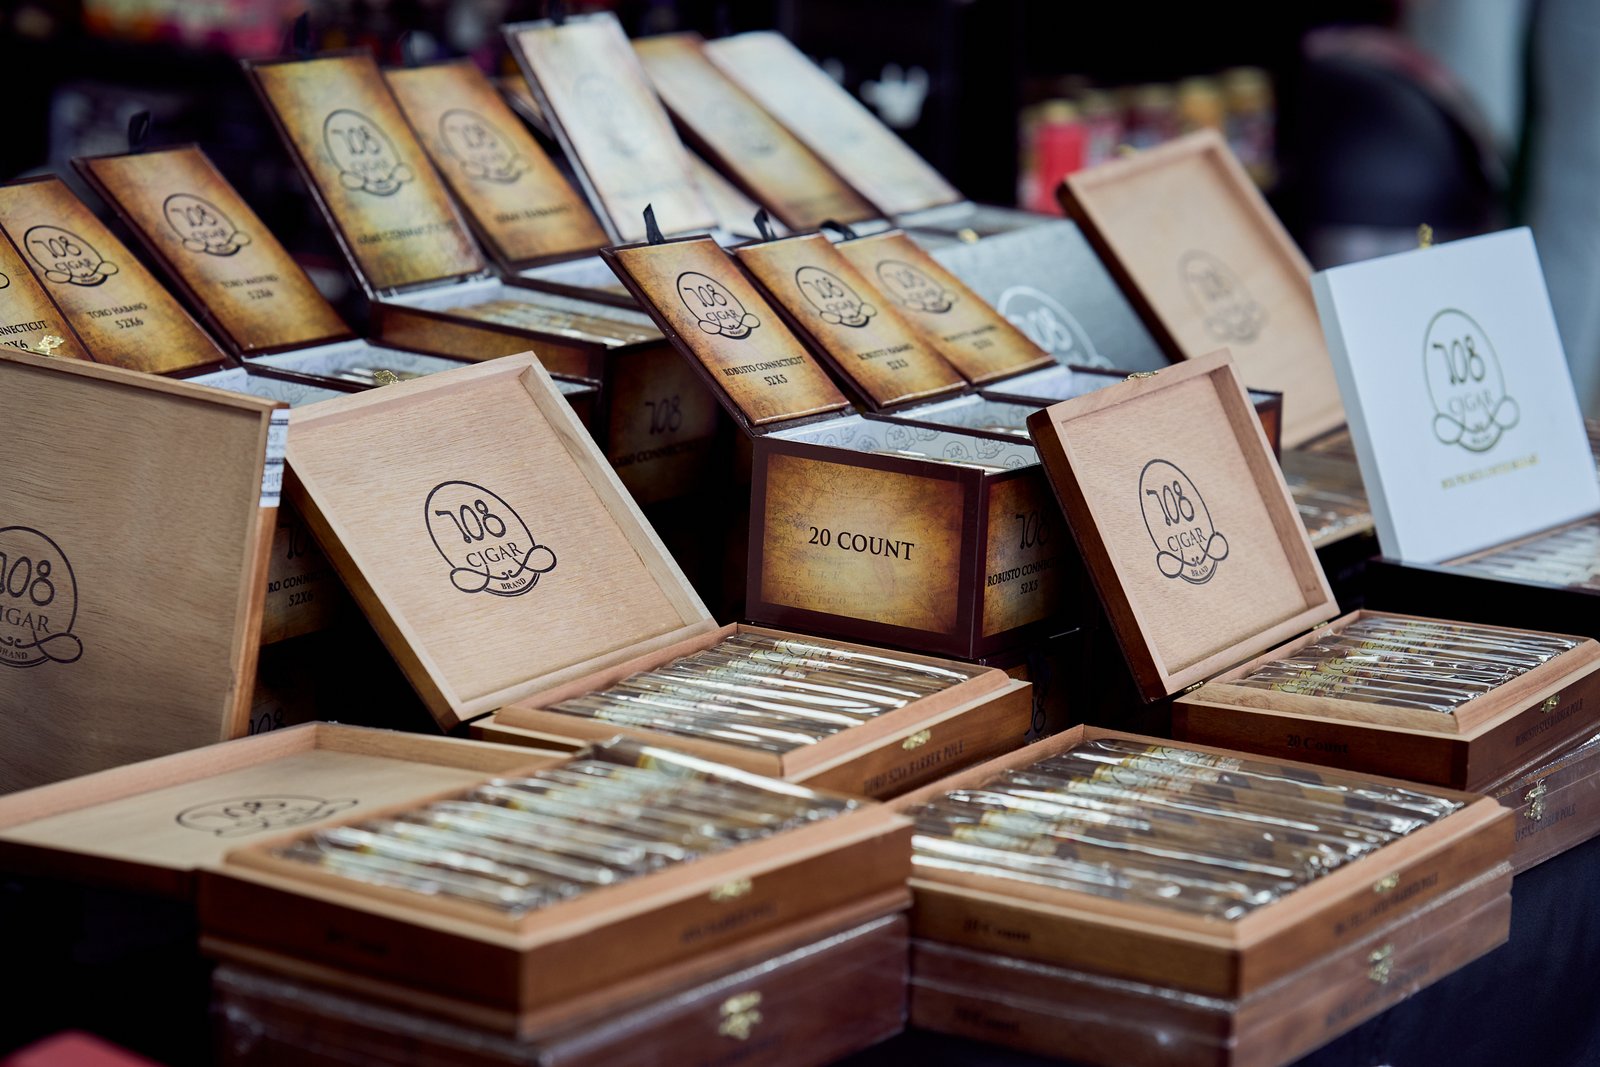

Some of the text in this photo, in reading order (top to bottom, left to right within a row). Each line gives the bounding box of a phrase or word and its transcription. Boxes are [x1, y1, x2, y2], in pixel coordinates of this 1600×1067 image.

[170, 204, 217, 227] 708
[31, 235, 82, 258] 708
[54, 258, 97, 272] CIGAR
[683, 284, 728, 308] 708
[802, 276, 844, 299] 708
[706, 309, 741, 322] CIGAR
[722, 355, 806, 377] ROBUSTO CONNECTICUT
[1431, 334, 1487, 386] 708
[763, 373, 788, 386] 52X5
[1448, 389, 1494, 416] CIGAR
[1145, 480, 1195, 527] 708
[435, 499, 507, 544] 708
[808, 526, 915, 561] 20 COUNT
[1166, 527, 1208, 553] CIGAR
[465, 541, 525, 569] CIGAR
[987, 567, 1021, 587] ROBUSTO
[1190, 564, 1209, 577] BRAND
[500, 577, 527, 590] BRAND
[1020, 579, 1039, 595] 52X5
[288, 590, 315, 607] 52X6
[1303, 737, 1349, 753] Count
